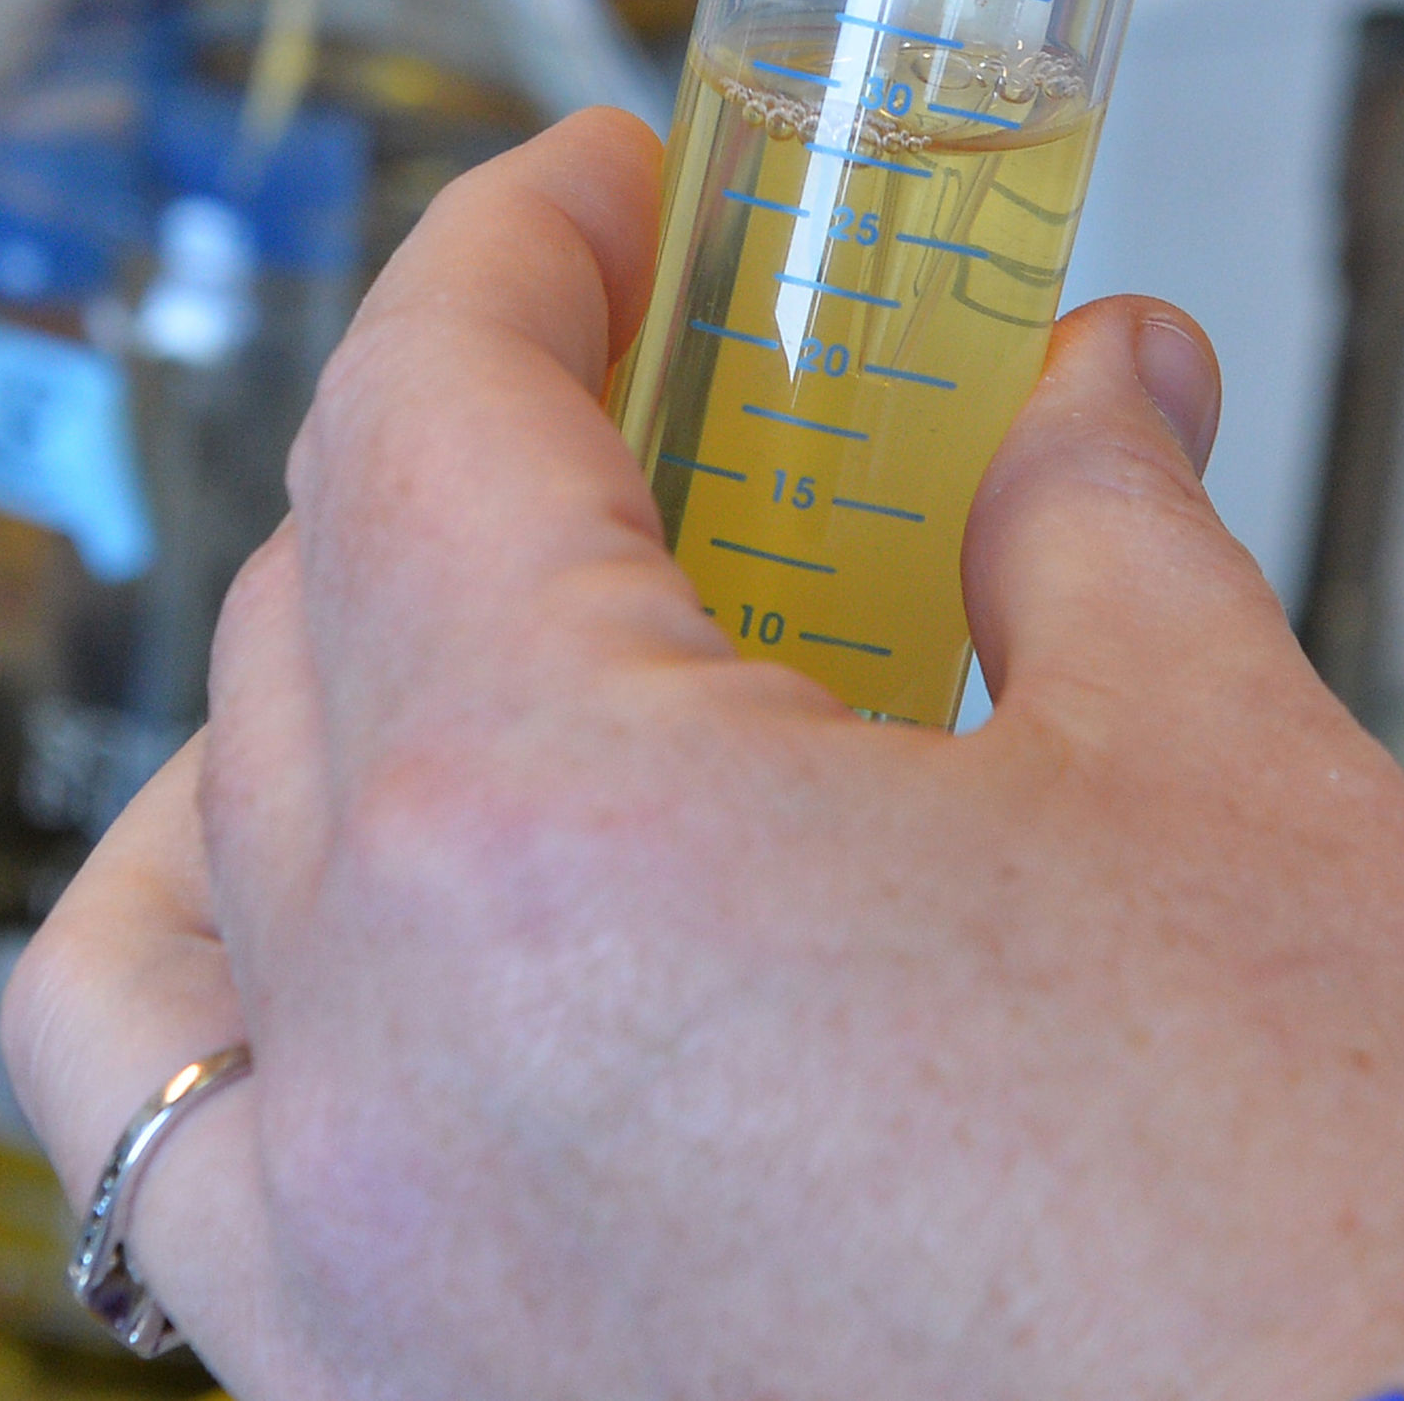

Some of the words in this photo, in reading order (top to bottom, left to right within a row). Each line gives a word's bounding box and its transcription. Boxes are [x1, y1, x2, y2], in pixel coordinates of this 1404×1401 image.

[859, 79, 913, 117] 30
[828, 206, 880, 245] 25
[796, 339, 850, 379] 20
[772, 470, 816, 510] 15
[739, 605, 785, 645] 10
